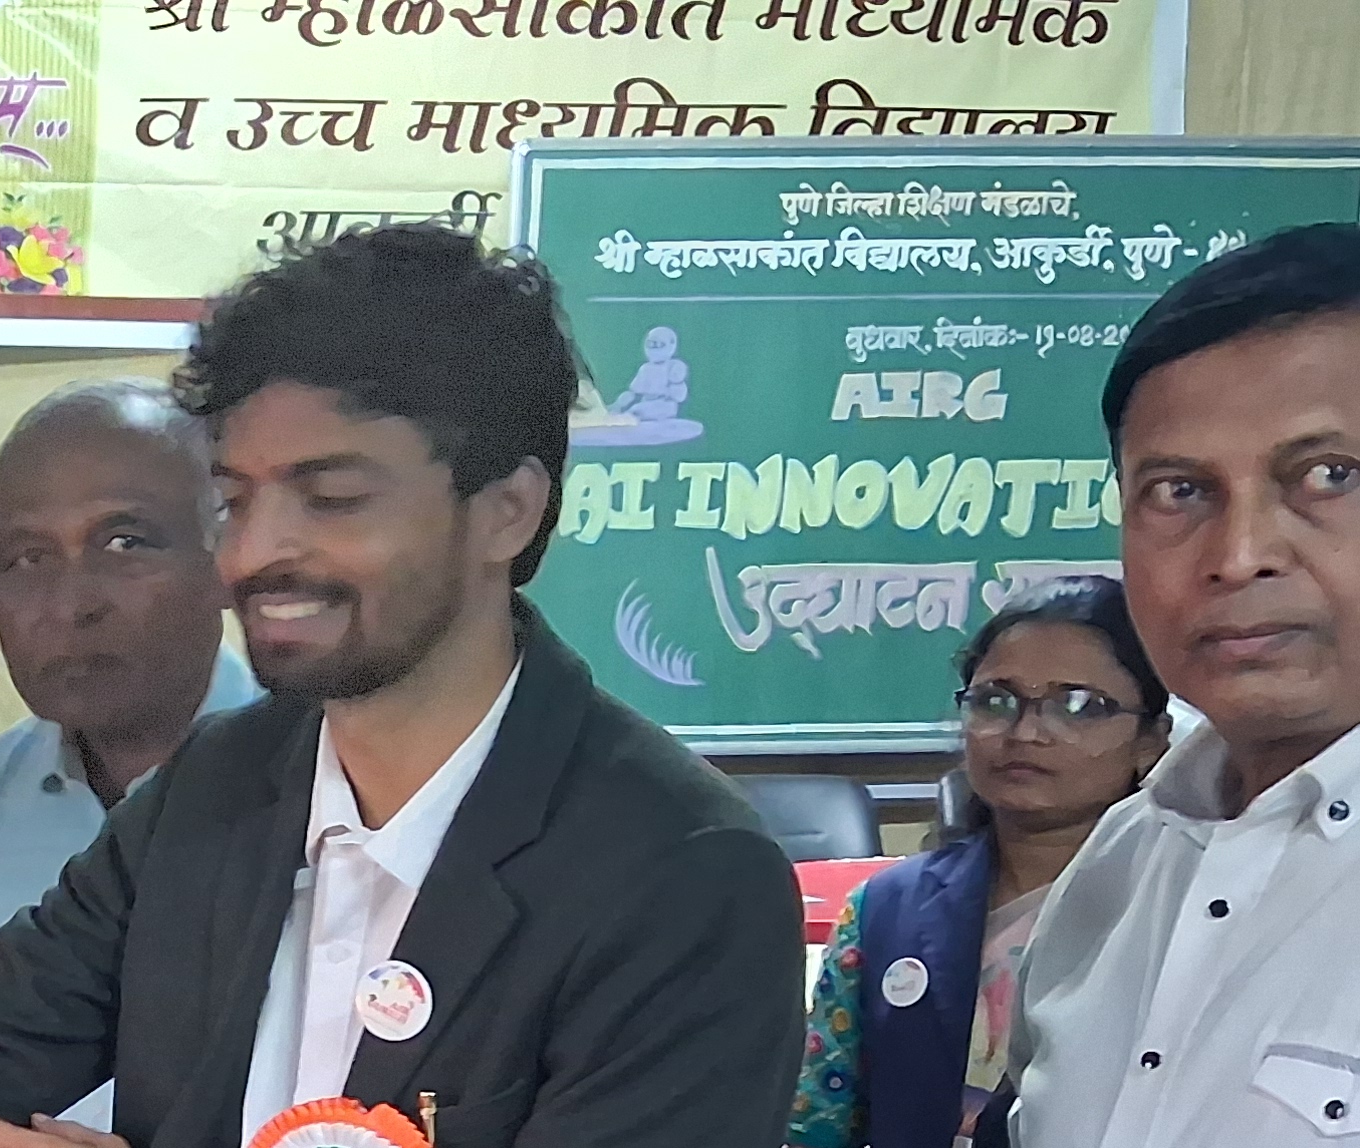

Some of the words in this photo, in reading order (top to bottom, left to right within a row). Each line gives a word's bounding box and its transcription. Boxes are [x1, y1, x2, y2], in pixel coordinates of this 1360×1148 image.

[135, 97, 210, 150] व
[225, 97, 388, 152] उच्च
[779, 182, 823, 226] पुणे
[826, 181, 894, 218] जिल्हा
[897, 180, 976, 228] शिक्षण
[594, 229, 642, 274] श्री
[643, 229, 830, 279] म्हाळसाकांत
[1120, 223, 1182, 281] पुणे
[558, 461, 661, 544] AI
